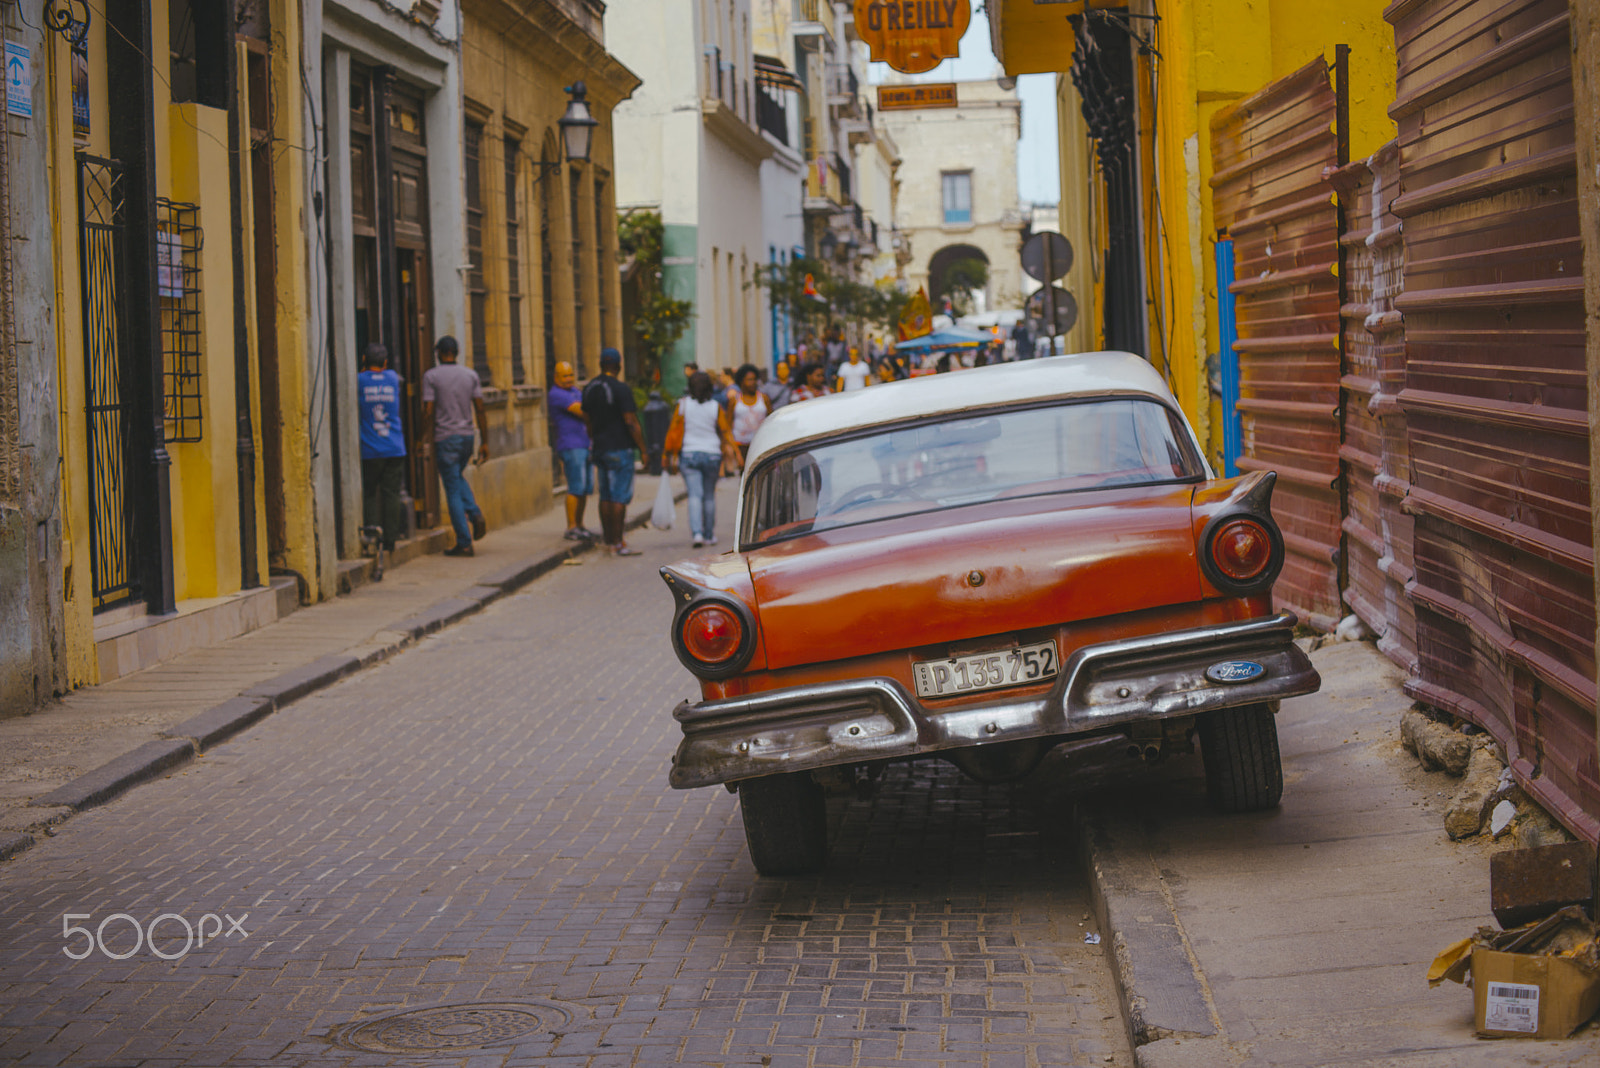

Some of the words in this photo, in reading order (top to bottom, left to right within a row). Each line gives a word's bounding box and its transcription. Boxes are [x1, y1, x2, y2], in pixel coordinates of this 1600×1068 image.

[868, 0, 957, 31] O'REILLY
[920, 667, 929, 692] CUBA
[1220, 663, 1252, 678] Ford
